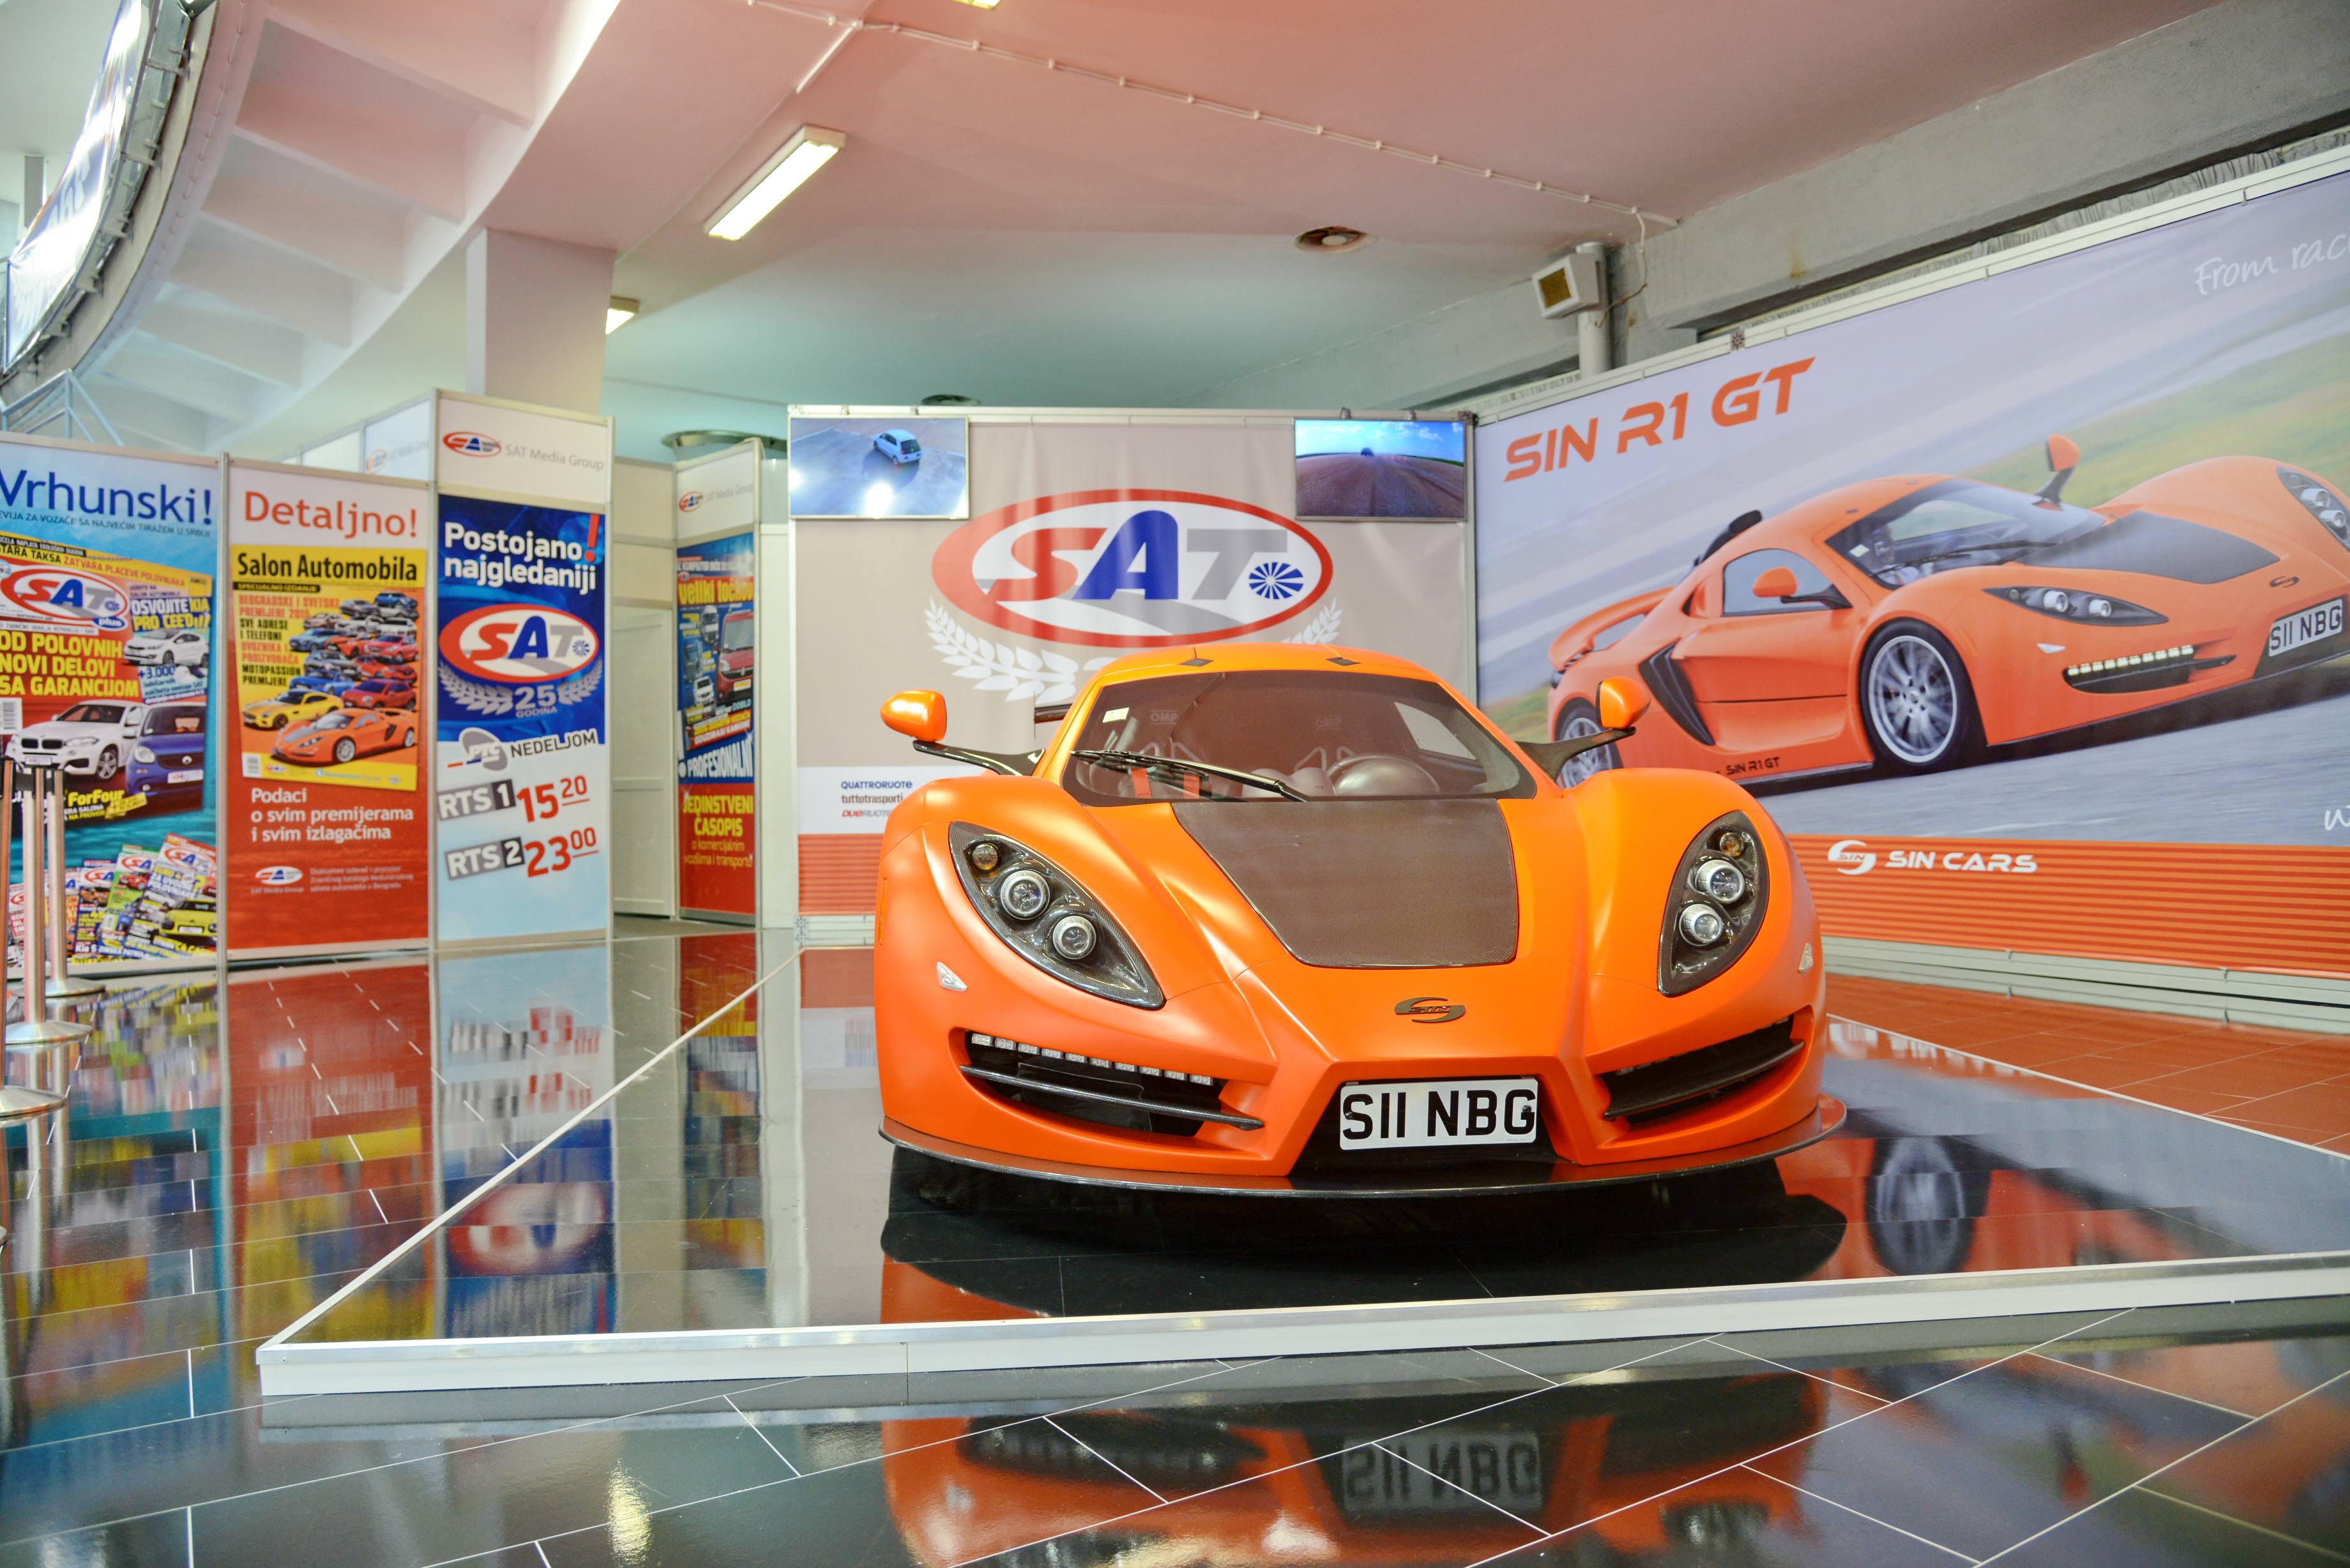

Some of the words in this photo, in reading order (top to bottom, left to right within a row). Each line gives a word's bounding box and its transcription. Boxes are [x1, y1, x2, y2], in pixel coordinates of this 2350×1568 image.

[2194, 256, 2278, 295] From
[2291, 234, 2350, 270] rac
[1503, 418, 1598, 483] SIN
[1616, 391, 1688, 455] R1
[1711, 356, 1816, 427] GT
[505, 445, 527, 458] SAT
[531, 449, 566, 464] Media
[568, 455, 604, 471] Group
[0, 470, 211, 525] Vrhunski!
[26, 513, 38, 522] ZA
[41, 513, 74, 525] VOZAČE
[79, 518, 90, 526] SA
[245, 491, 416, 539] Detaljno!
[0, 544, 27, 557] TARA
[31, 550, 61, 563] TAKSA
[64, 555, 103, 571] ZATVARA
[238, 552, 291, 577] Salon
[298, 554, 417, 580] Automobila
[985, 510, 1287, 600] SAT
[444, 556, 596, 594] najgledaniji
[20, 578, 116, 610] SAT
[679, 580, 715, 605] veliki
[717, 579, 754, 603] točkov
[131, 598, 188, 615] OSVOJITE
[189, 597, 210, 614] KIA
[133, 614, 160, 631] PRO
[240, 618, 254, 628] SVE
[257, 619, 288, 629] ADRESE
[247, 630, 282, 640] TELEFONI
[2300, 605, 2341, 640] NBG
[0, 630, 26, 652] OD
[32, 633, 123, 658] POLOVNIH
[472, 616, 584, 660] SAT
[0, 653, 47, 674] NOVI
[52, 656, 115, 677] DELOVI
[243, 664, 301, 675] MOTOPASSION
[0, 675, 26, 695] SA
[31, 676, 139, 697] GARANCIJOM
[243, 675, 287, 686] PREMIJERE
[515, 685, 556, 711] 25
[516, 706, 557, 718] GODINA
[511, 732, 596, 758] NEDELJOM
[686, 739, 754, 778] PROFESIONALNI
[1765, 757, 1780, 768] GT
[68, 789, 125, 807] ForFour
[251, 788, 307, 804] Podaci
[438, 788, 492, 819] RTS
[497, 783, 511, 807] 1
[516, 783, 559, 823] 15
[560, 775, 588, 798] 20
[683, 795, 754, 815] JEDINSTVENI
[842, 792, 904, 804] tuttotrasporti
[251, 811, 263, 823] o
[267, 808, 306, 823] svim
[311, 807, 413, 825] premijerama
[694, 813, 743, 837] ČASOPIS
[252, 827, 257, 842] i
[262, 826, 301, 842] svim
[307, 823, 391, 843] izlagačima
[447, 844, 501, 878] RTS
[504, 840, 522, 865] 2
[524, 835, 571, 878] 23
[570, 827, 596, 850] 00
[1884, 850, 1936, 870] SIN
[1943, 852, 2038, 873] CARS
[1427, 1089, 1536, 1137] NBG
